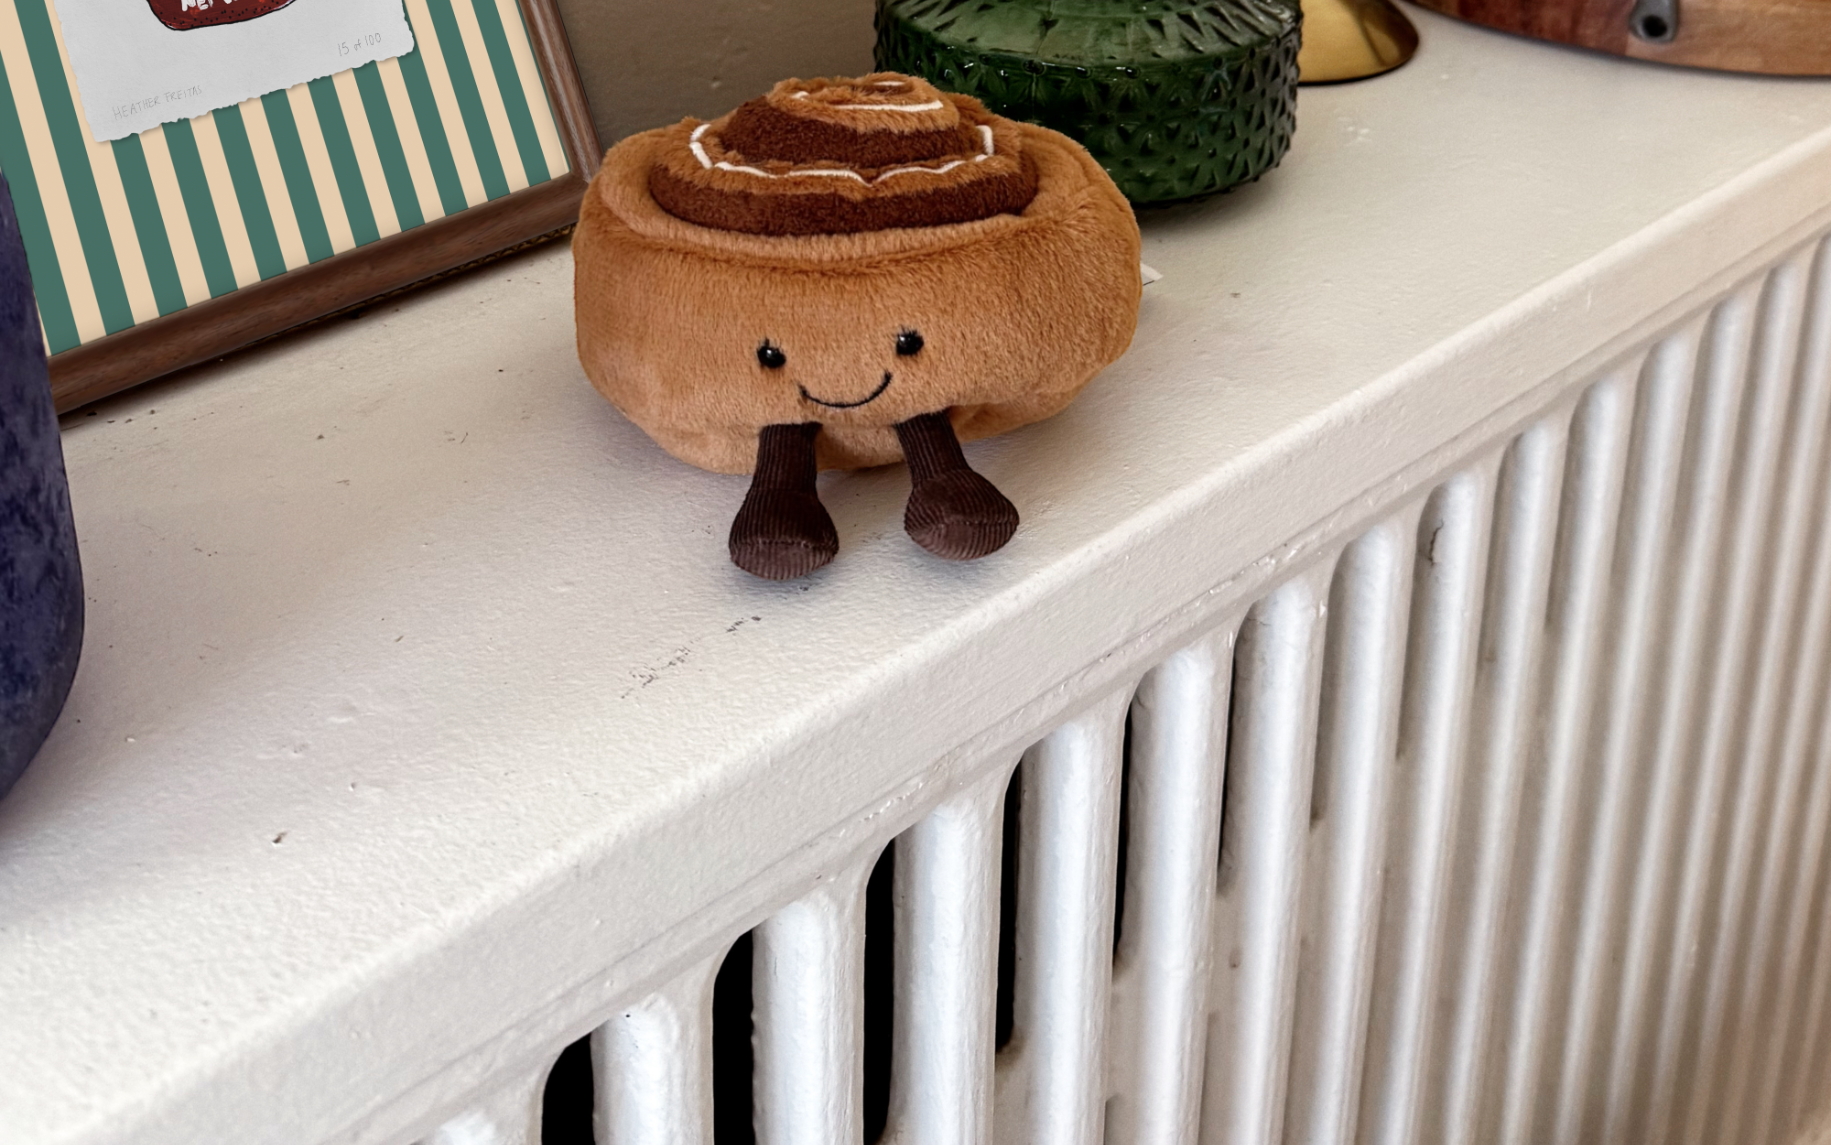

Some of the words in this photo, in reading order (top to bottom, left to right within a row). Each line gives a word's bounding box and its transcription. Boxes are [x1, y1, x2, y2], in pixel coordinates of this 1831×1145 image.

[337, 41, 350, 56] 15
[364, 32, 382, 46] 100
[112, 96, 161, 120] HEATHER
[163, 85, 202, 102] FREITAS
